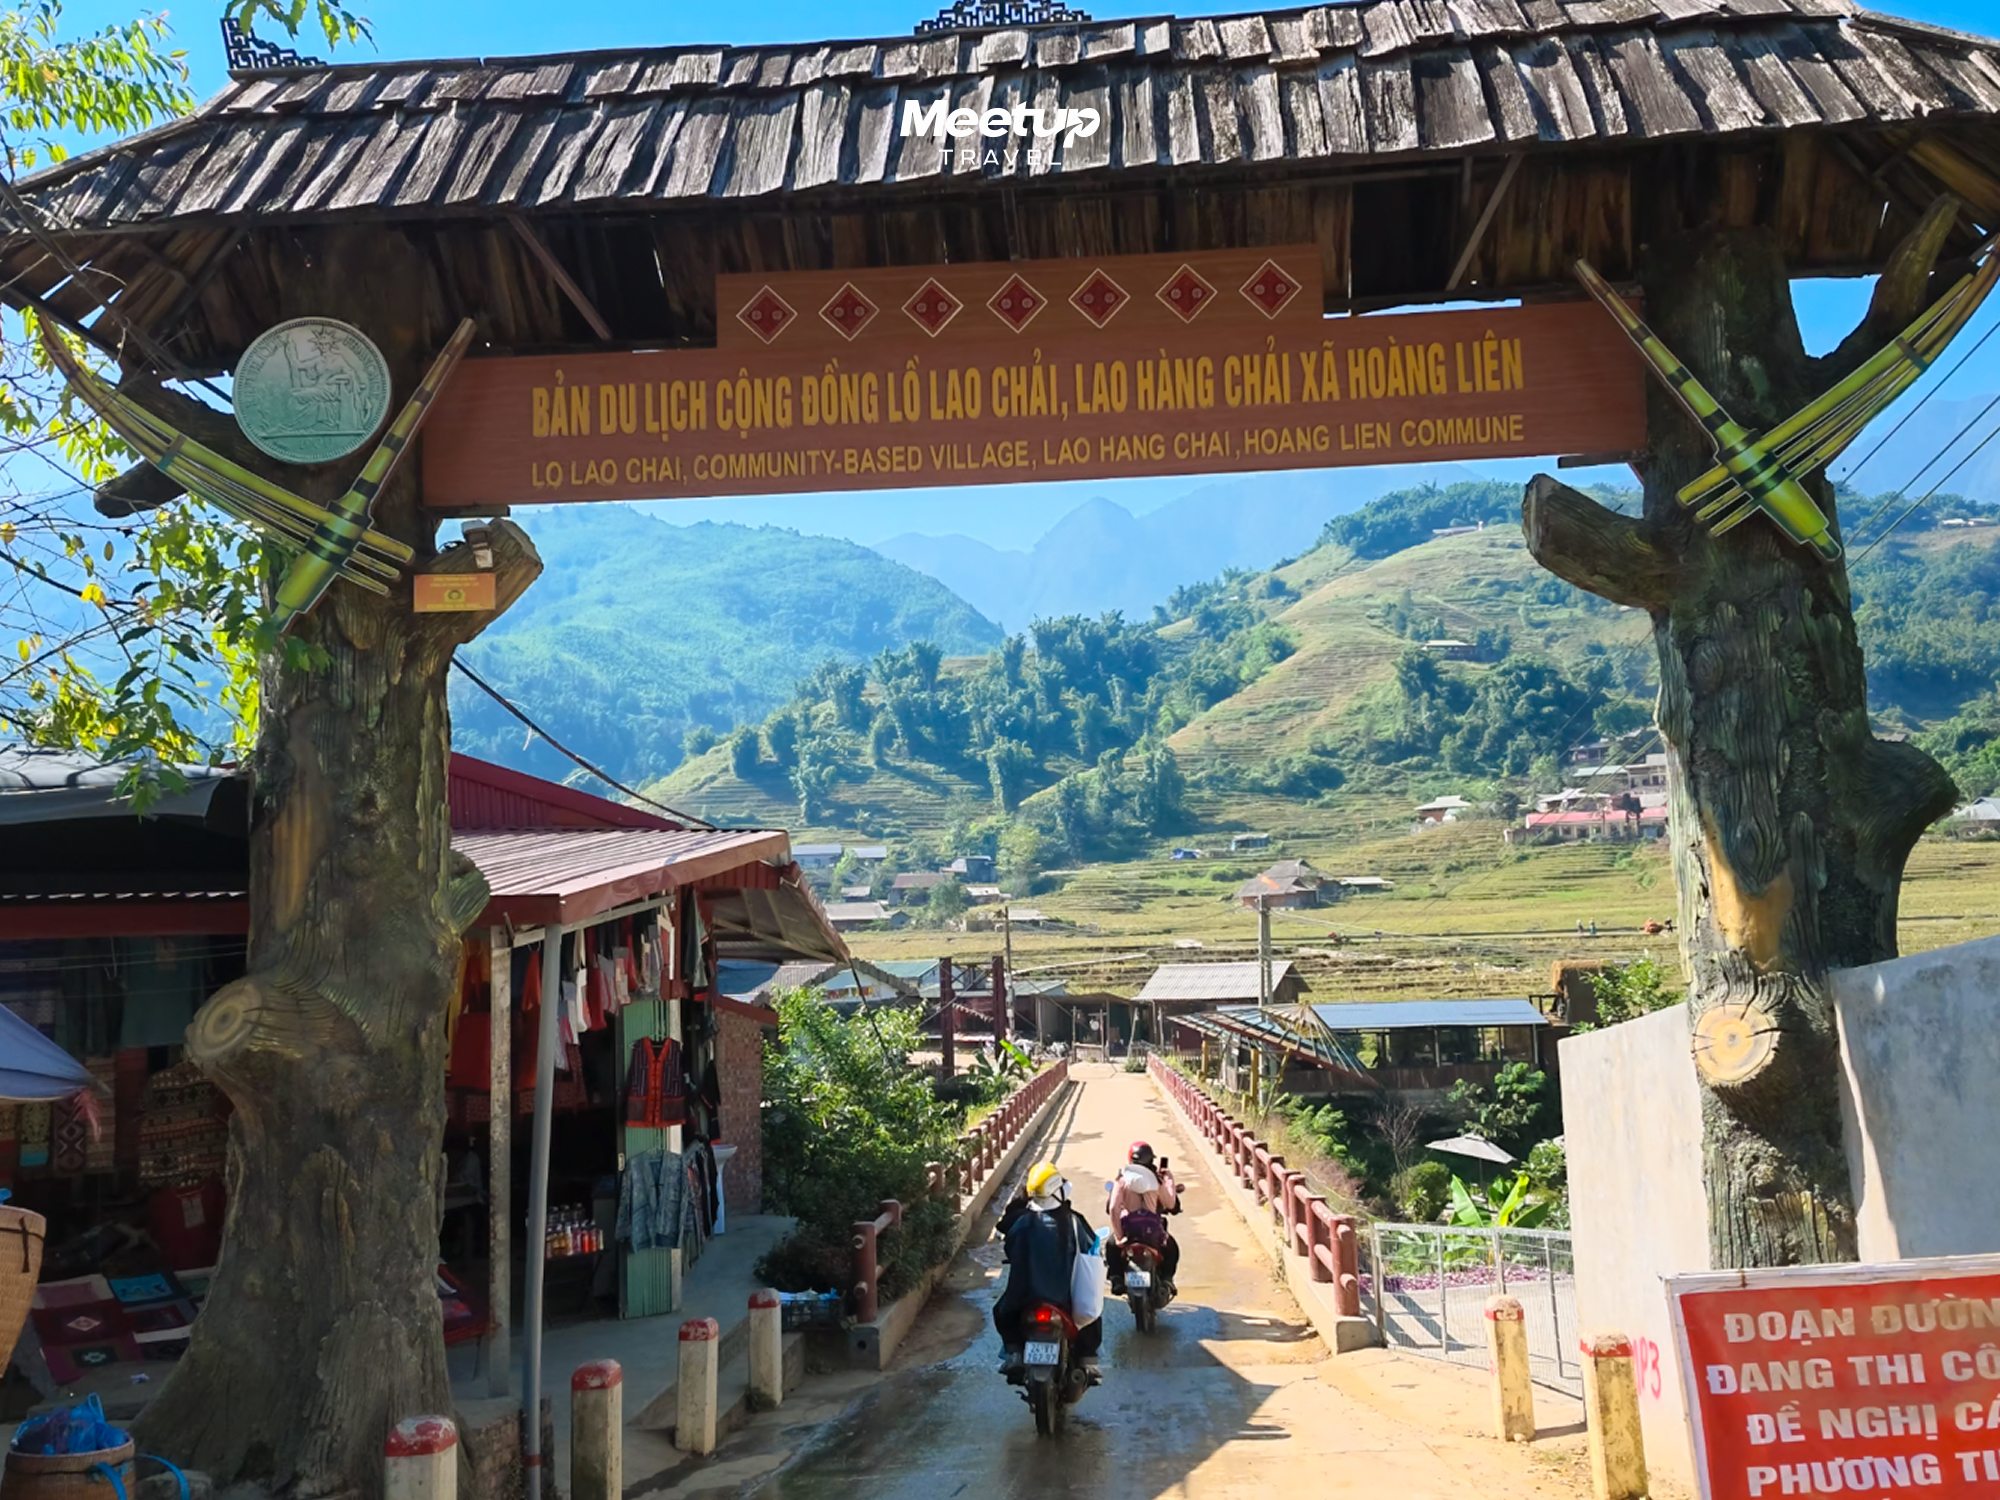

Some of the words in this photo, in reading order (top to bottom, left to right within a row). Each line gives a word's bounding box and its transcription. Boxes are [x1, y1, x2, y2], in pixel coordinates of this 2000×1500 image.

[533, 371, 590, 436] BẢN
[600, 384, 637, 433] DU
[645, 380, 707, 441] LỊCH
[716, 368, 792, 437] CỘNG
[801, 358, 879, 425] ĐỒNG
[888, 355, 921, 422] LỒ
[930, 368, 981, 421] LAO
[992, 348, 1068, 421] CHẢI,
[1076, 361, 1128, 414] LAO
[1137, 349, 1214, 411] HÀNG
[1224, 336, 1291, 408] CHẢI
[1300, 341, 1340, 402] XÃ
[1348, 336, 1447, 400] HOÀNG
[1456, 330, 1523, 393] LIÊN
[572, 459, 617, 485] LAO
[627, 457, 687, 486] CHAI,
[694, 447, 923, 480] COMMUNITY-BASED
[931, 440, 1037, 471] VILLAGE,
[1044, 438, 1091, 465] LAO
[1100, 433, 1165, 461] HANG
[1340, 422, 1391, 451] LIEN
[1401, 416, 1522, 447] COMMUNE
[1723, 1306, 1856, 1346] ĐOẠN
[1870, 1292, 2000, 1336] ĐƯỜN
[1706, 1357, 1835, 1395] ĐANG
[1847, 1353, 1927, 1387] THI
[1746, 1400, 1806, 1446] ĐỀ
[1818, 1404, 1938, 1441] NGHỊ
[1746, 1453, 1942, 1497] PHƯƠNG
[1954, 1449, 2000, 1483] TI
